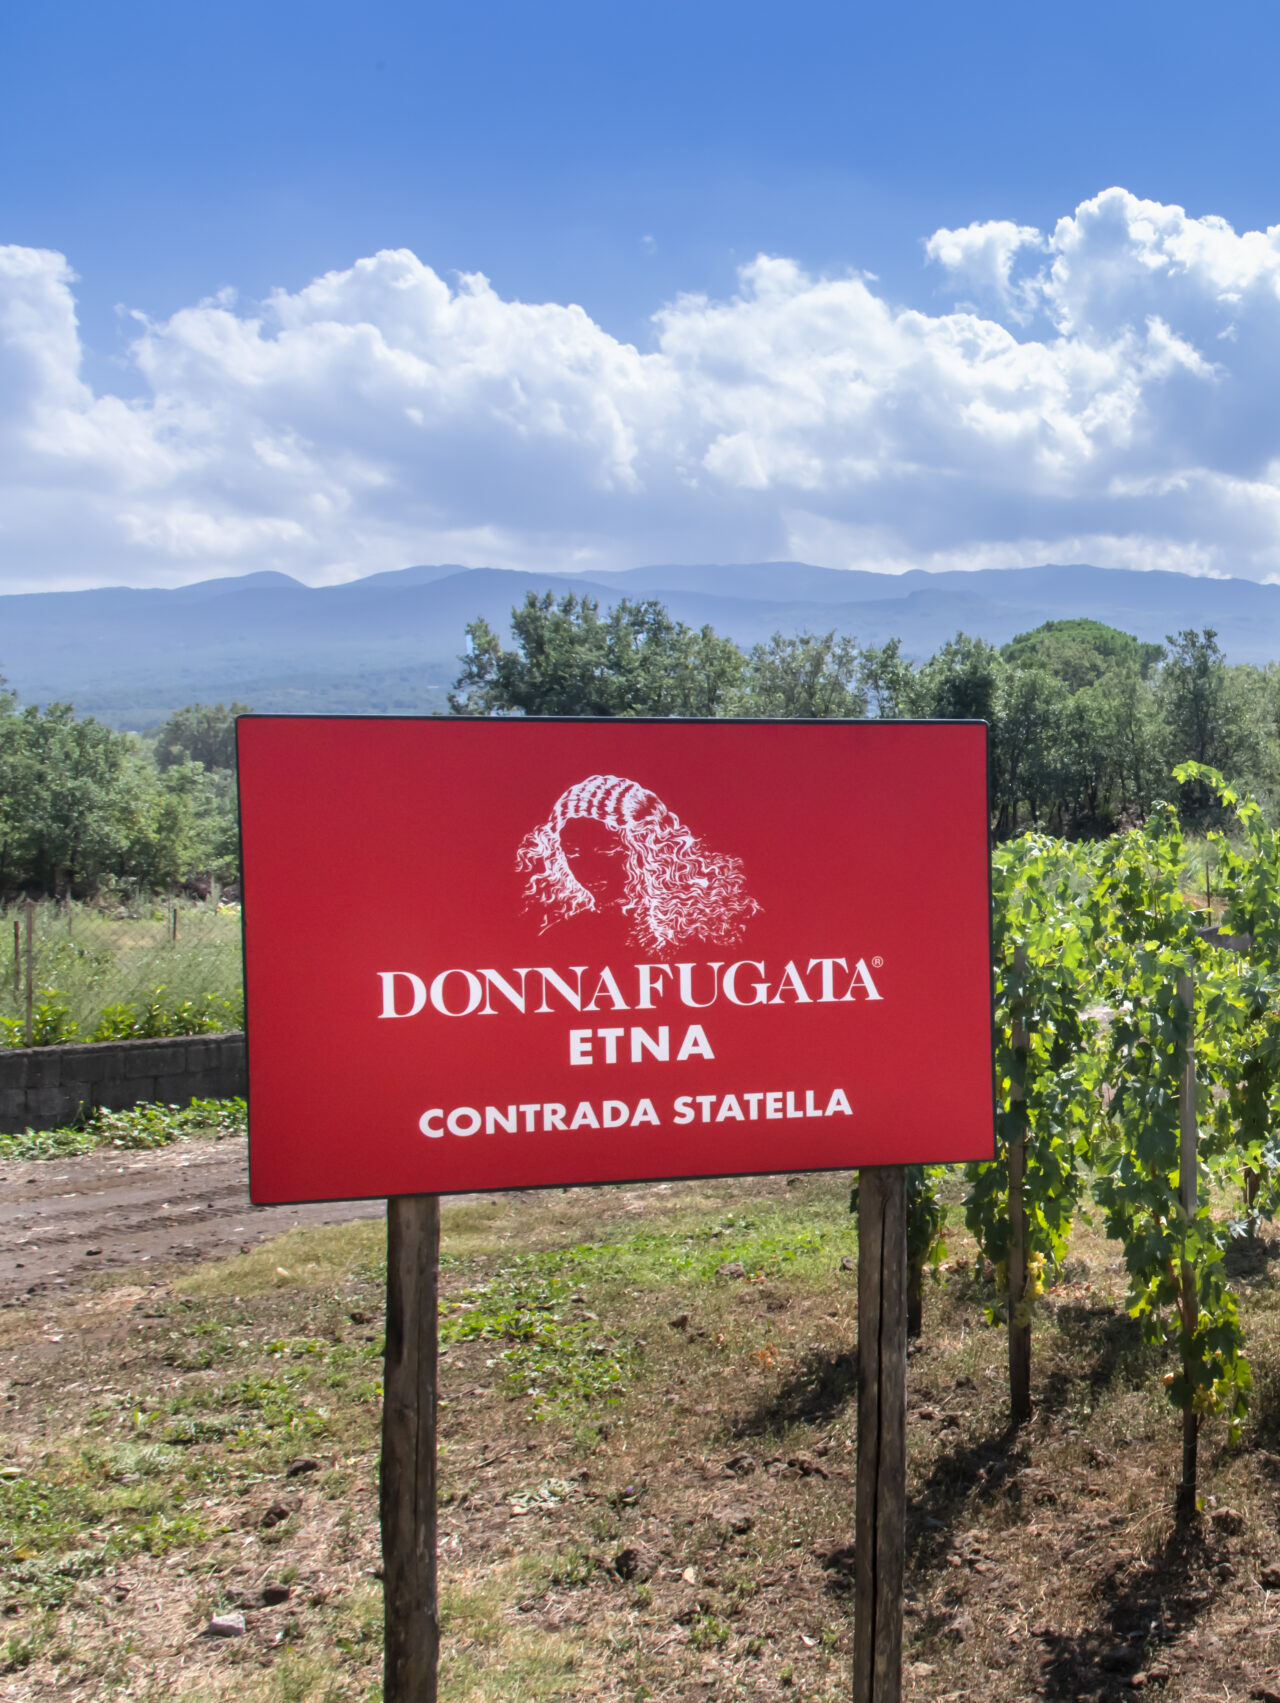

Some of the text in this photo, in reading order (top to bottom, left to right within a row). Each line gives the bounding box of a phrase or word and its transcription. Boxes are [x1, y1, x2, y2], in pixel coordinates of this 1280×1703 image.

[569, 1024, 715, 1066] ETNA
[418, 1088, 854, 1138] CONTRADA STATELLA
